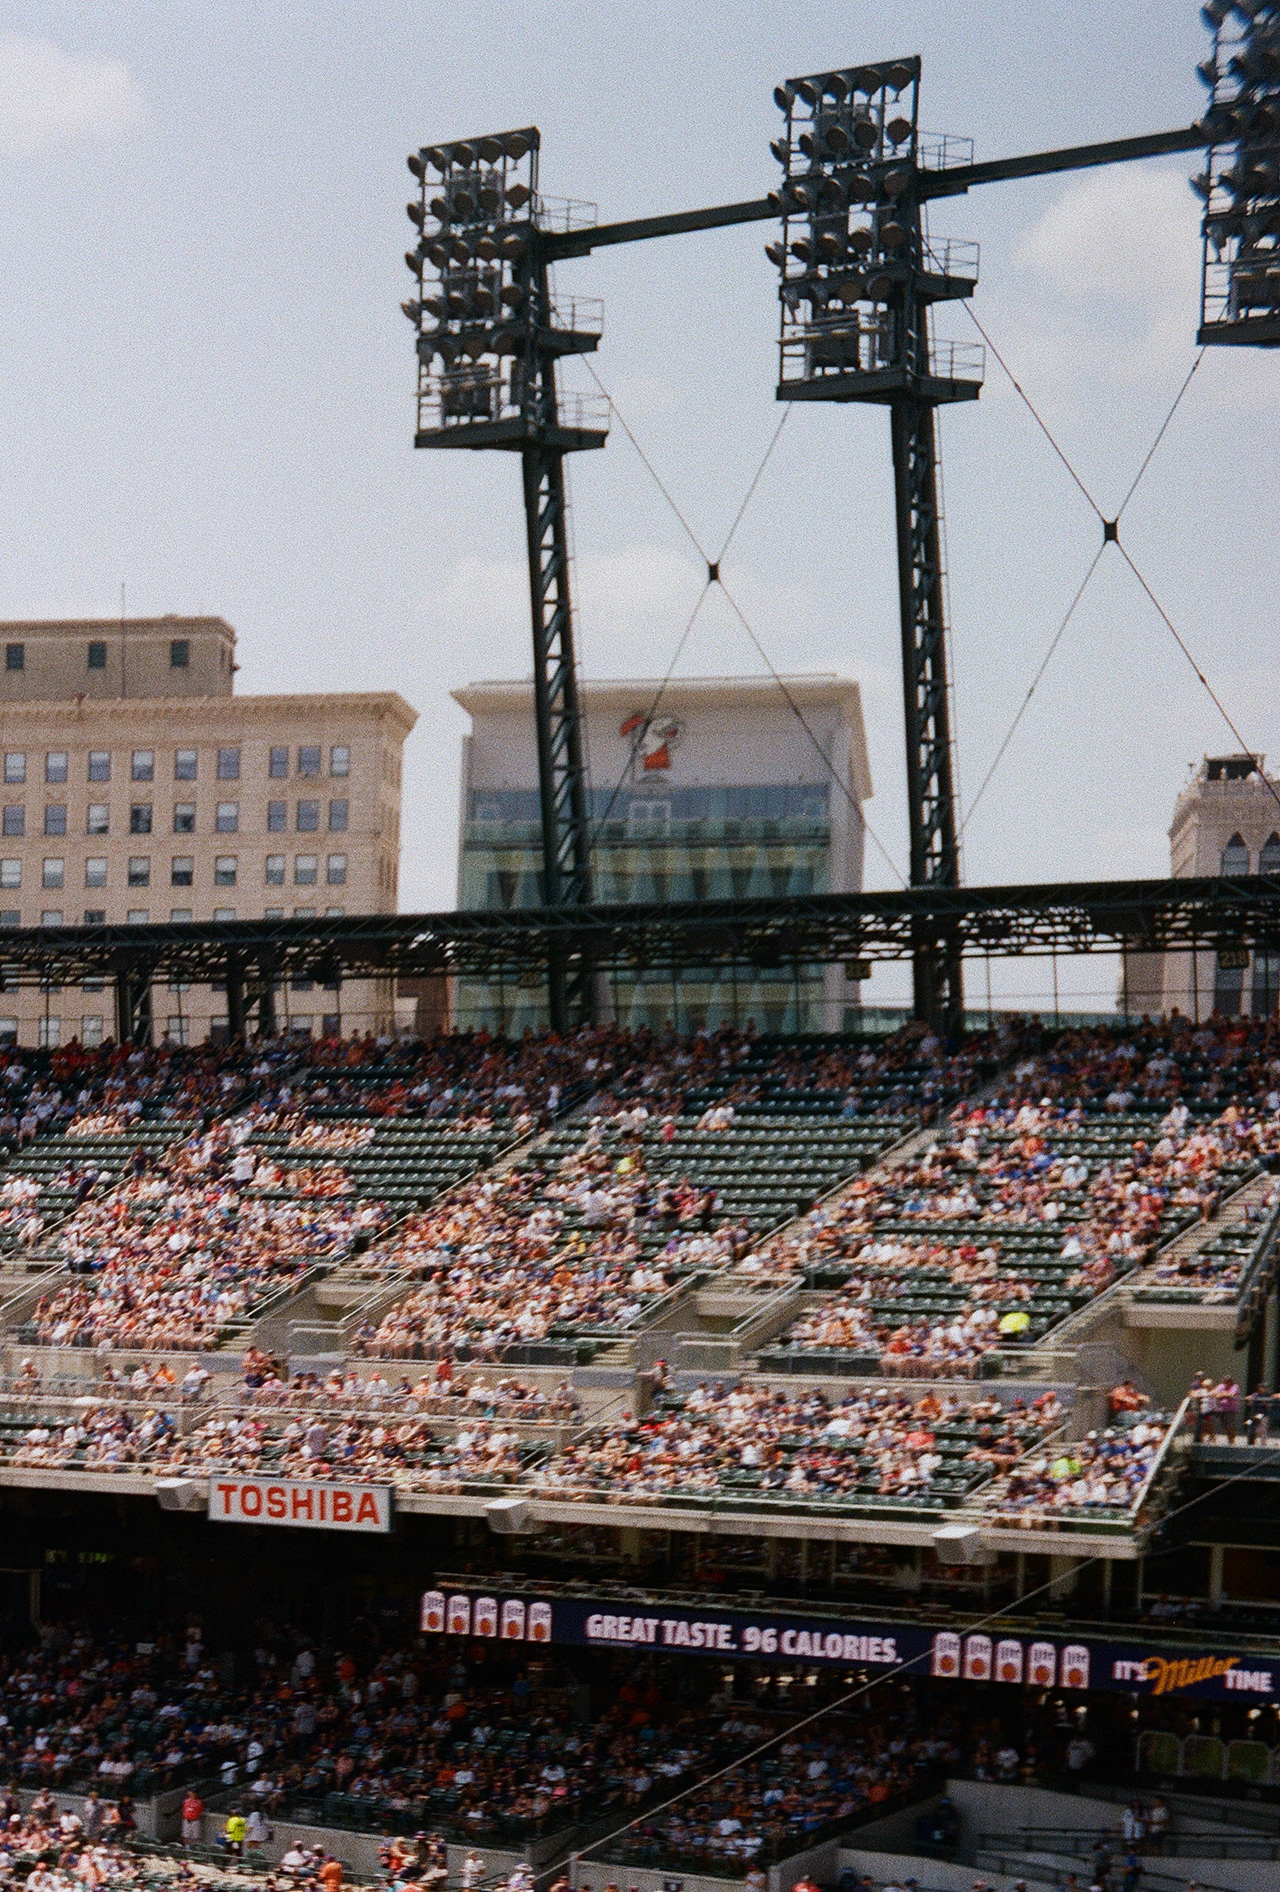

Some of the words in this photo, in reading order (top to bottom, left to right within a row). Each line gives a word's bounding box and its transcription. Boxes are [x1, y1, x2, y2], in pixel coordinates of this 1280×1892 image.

[217, 1484, 381, 1525] TOSHIBA
[586, 1613, 660, 1643] GREAT
[661, 1619, 738, 1650] TASTE.
[743, 1626, 778, 1654] 96
[780, 1629, 904, 1664] CALORIES.
[1144, 1656, 1241, 1696] Miller
